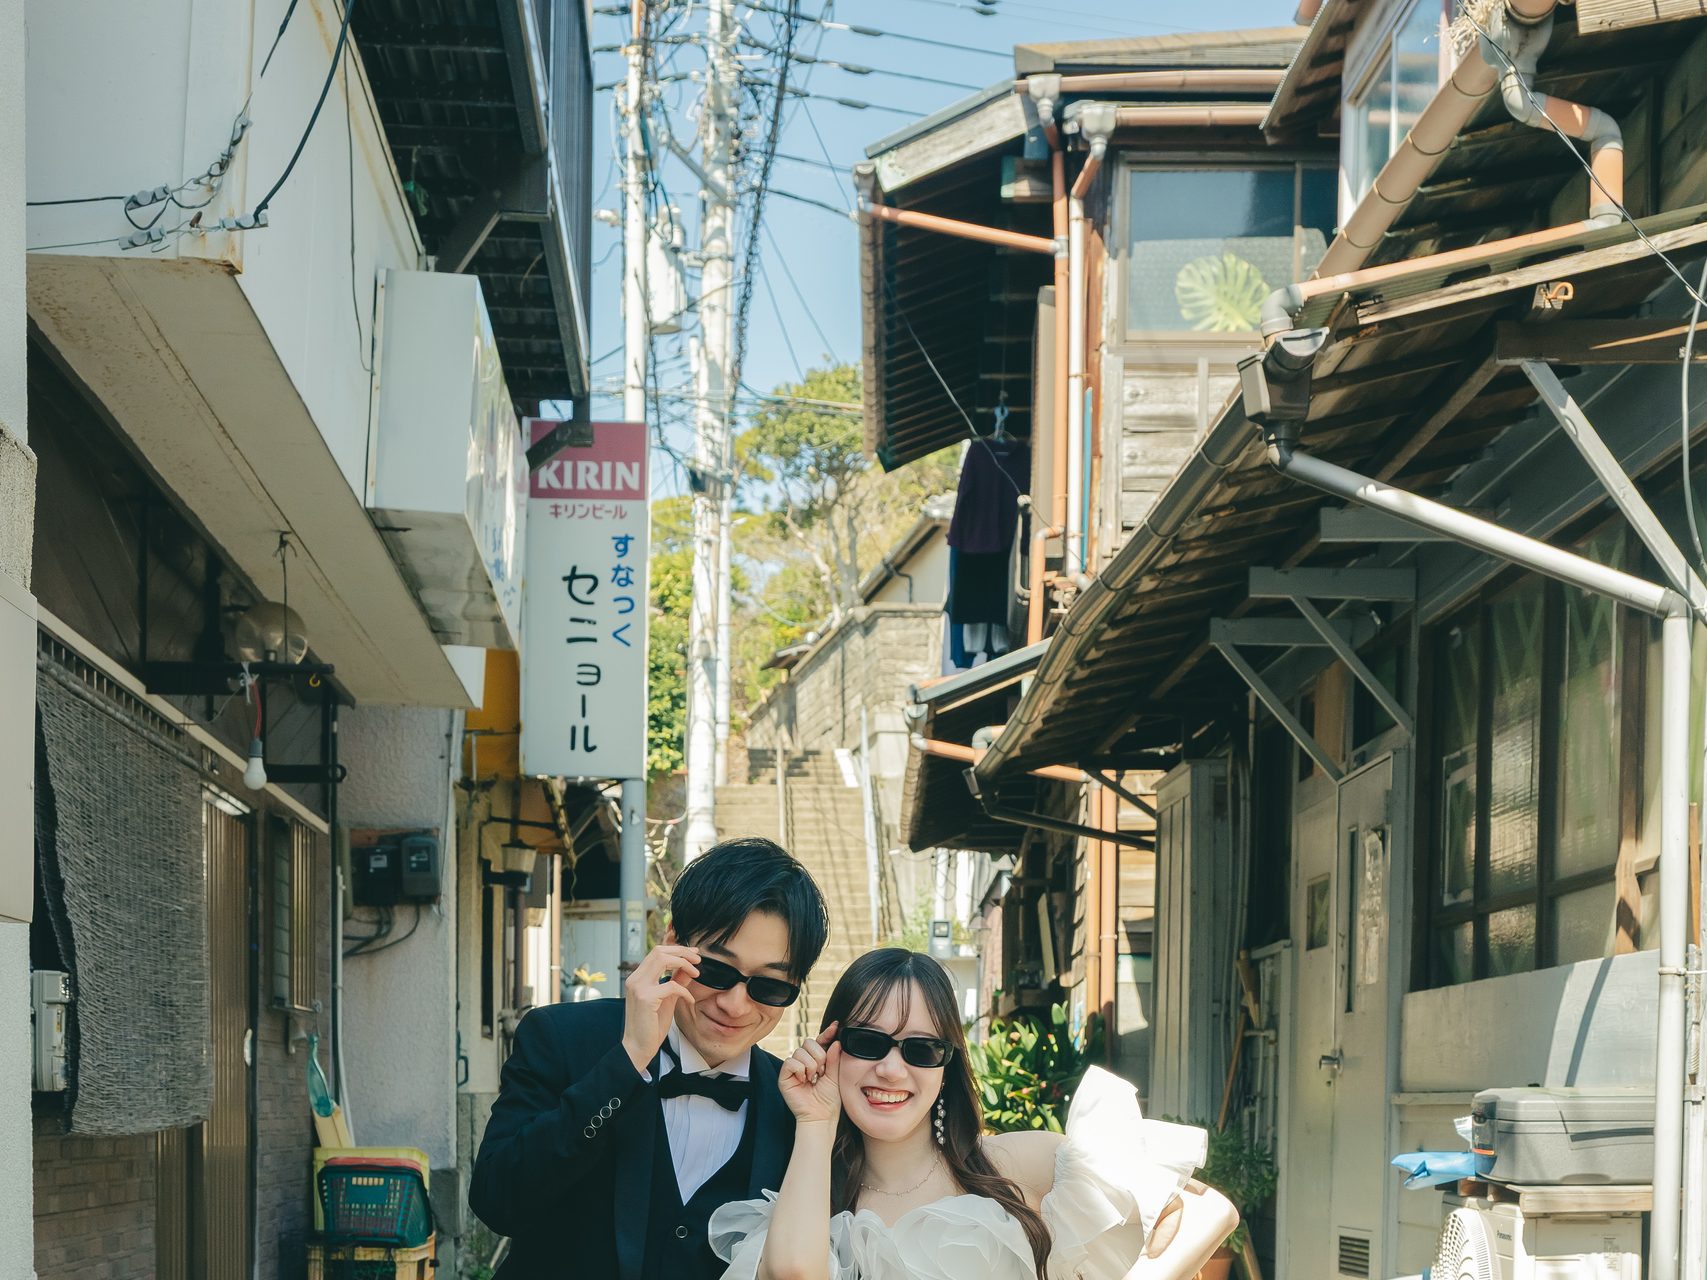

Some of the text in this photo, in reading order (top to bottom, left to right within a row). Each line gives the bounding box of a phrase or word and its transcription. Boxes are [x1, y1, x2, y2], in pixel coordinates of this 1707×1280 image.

[538, 460, 640, 491] KIRIN
[549, 503, 628, 519] キリンビール
[562, 565, 602, 753] セニョール
